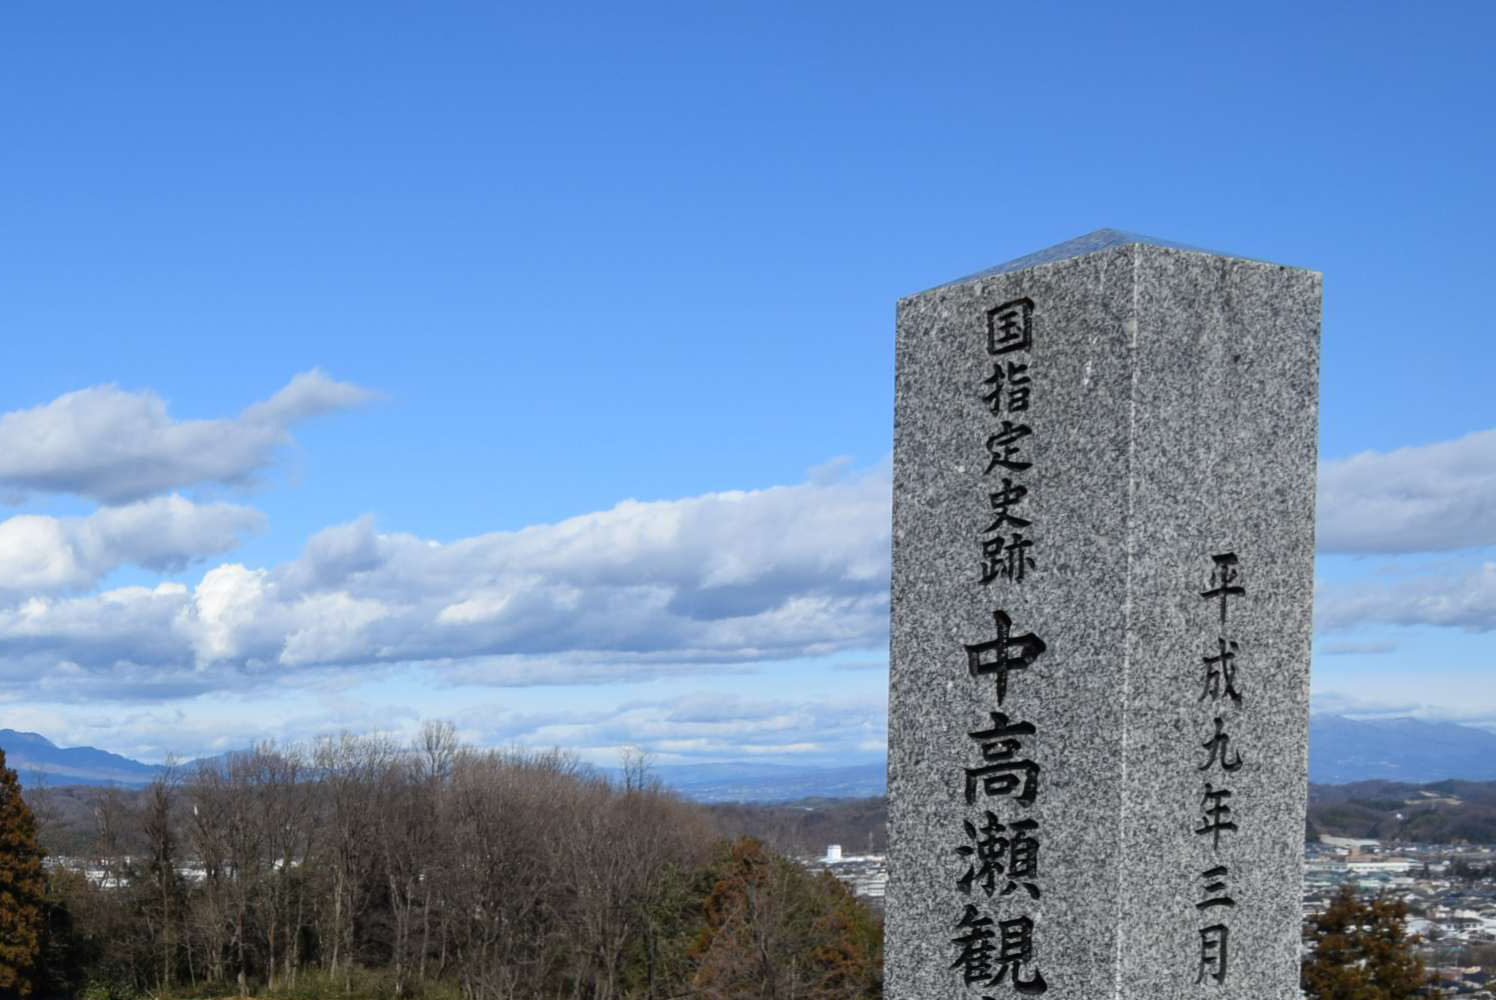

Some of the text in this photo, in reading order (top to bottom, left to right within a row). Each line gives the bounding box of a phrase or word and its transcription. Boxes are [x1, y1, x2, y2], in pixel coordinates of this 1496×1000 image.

[978, 296, 1035, 585] 国指定史跡
